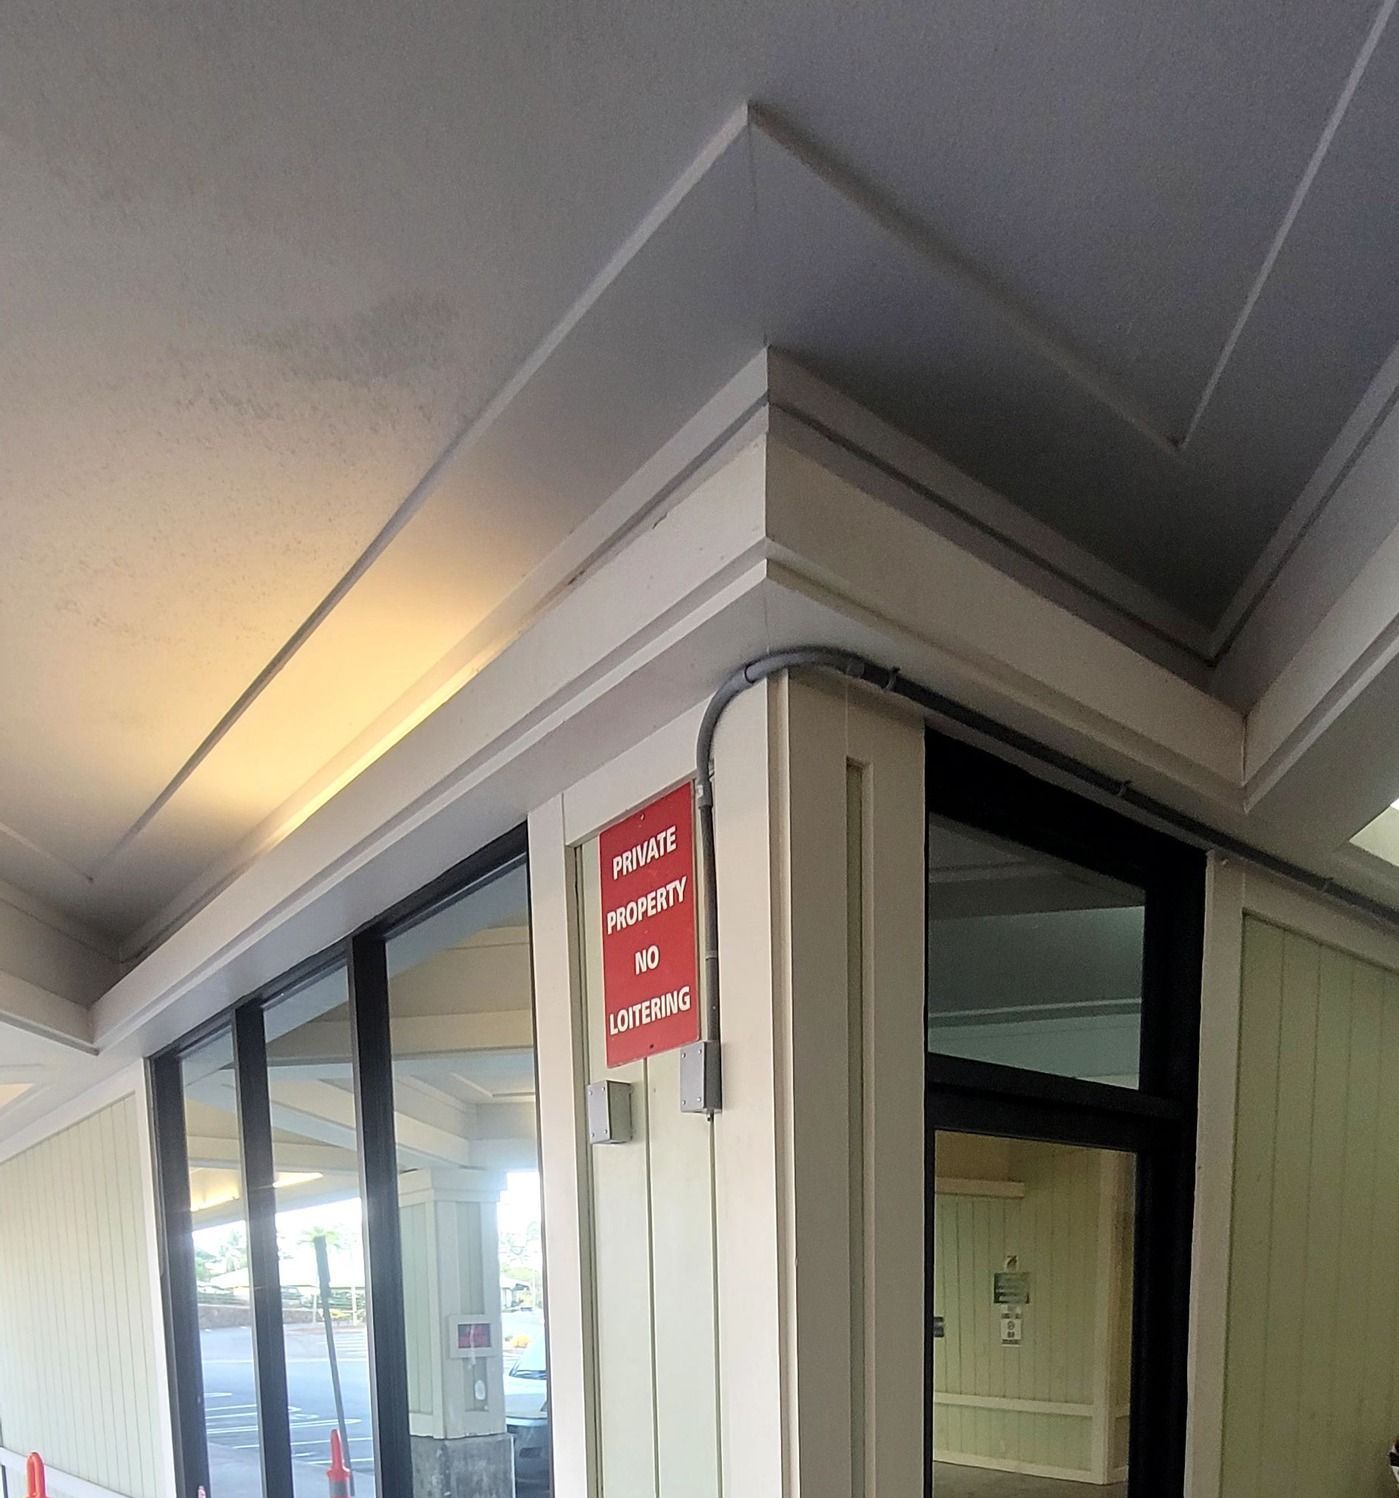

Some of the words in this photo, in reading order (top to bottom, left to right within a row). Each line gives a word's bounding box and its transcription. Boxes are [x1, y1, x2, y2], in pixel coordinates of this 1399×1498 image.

[612, 825, 677, 880] PRIVATE
[606, 877, 687, 935] PROPERTY
[635, 945, 660, 976] NO
[609, 986, 691, 1036] LOITERING
